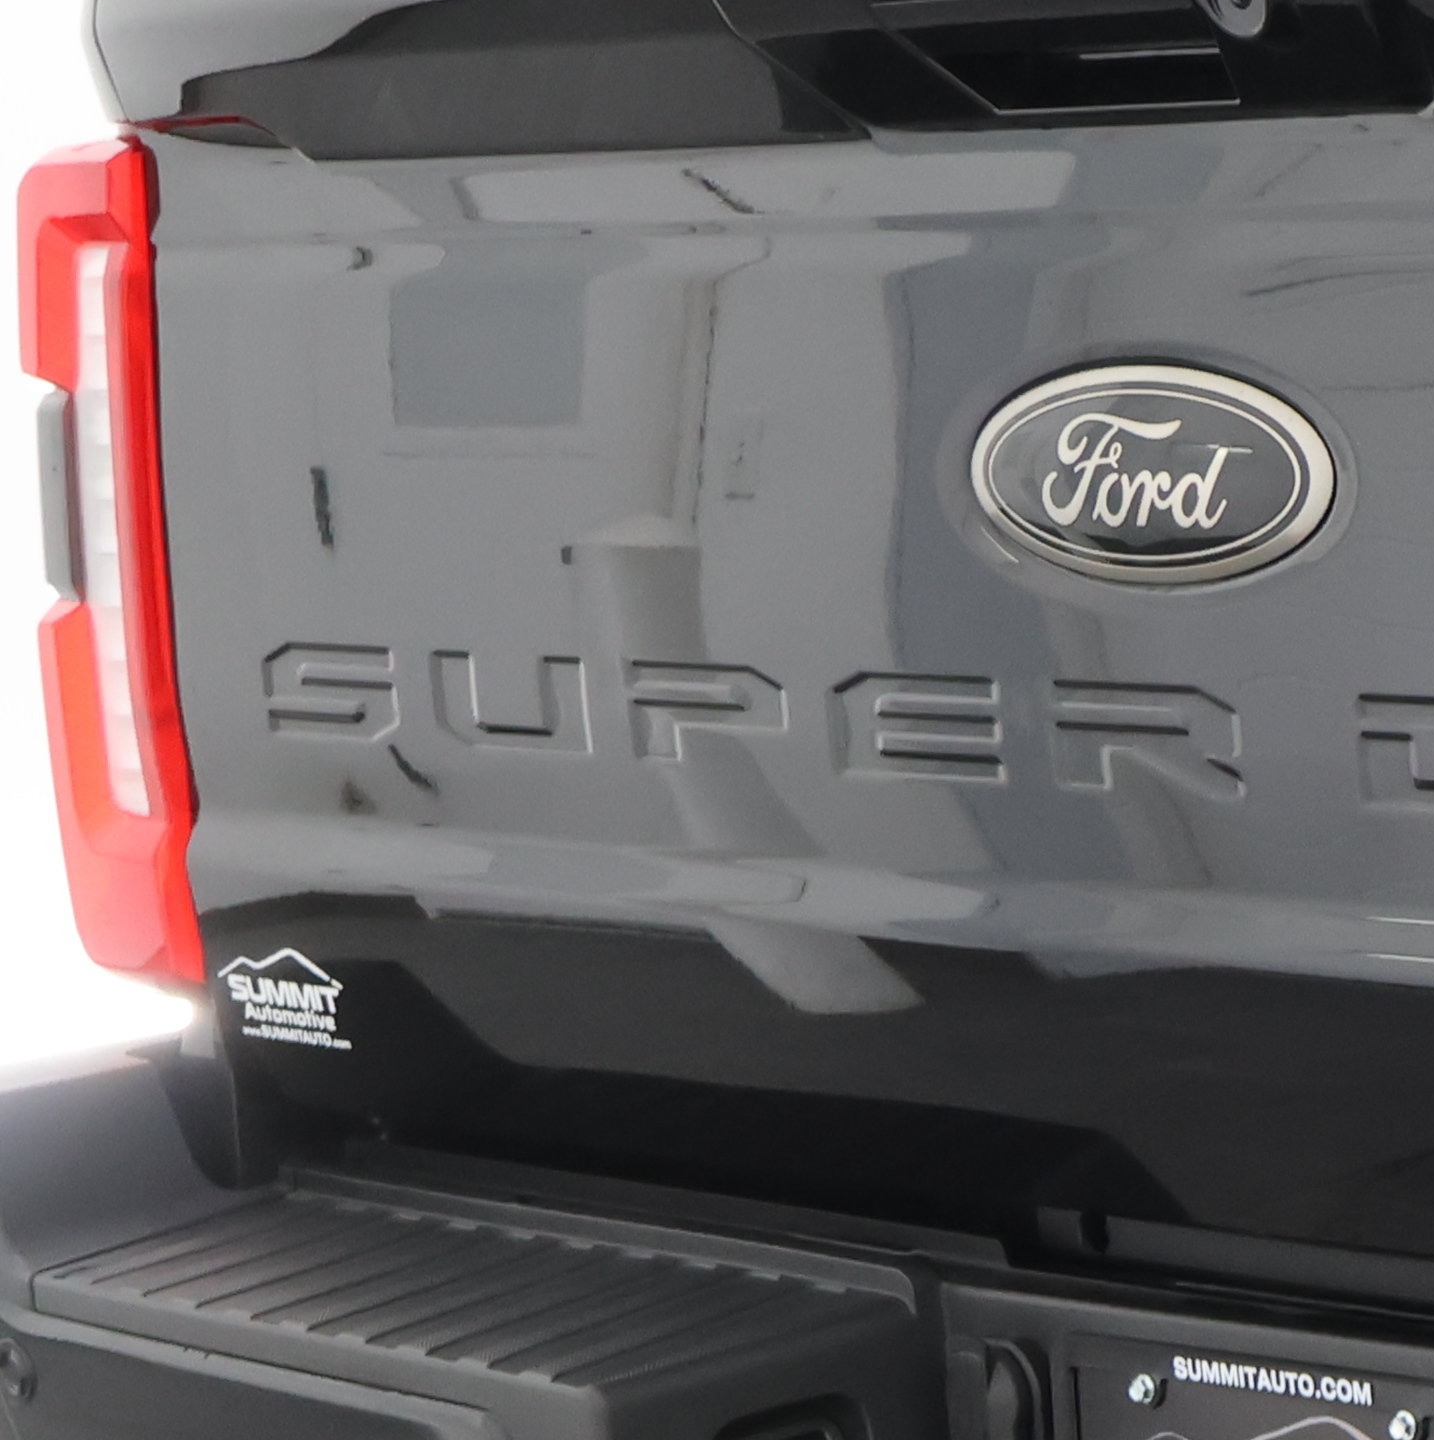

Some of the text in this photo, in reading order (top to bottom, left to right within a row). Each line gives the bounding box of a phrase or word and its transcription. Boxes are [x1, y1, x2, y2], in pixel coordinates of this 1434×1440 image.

[1042, 412, 1228, 529] Ford
[262, 640, 1246, 800] SUPER
[227, 973, 340, 1015] SUMMIT
[243, 1001, 337, 1033] Automotive
[1172, 1354, 1374, 1408] SUMMITAUTO.COM
